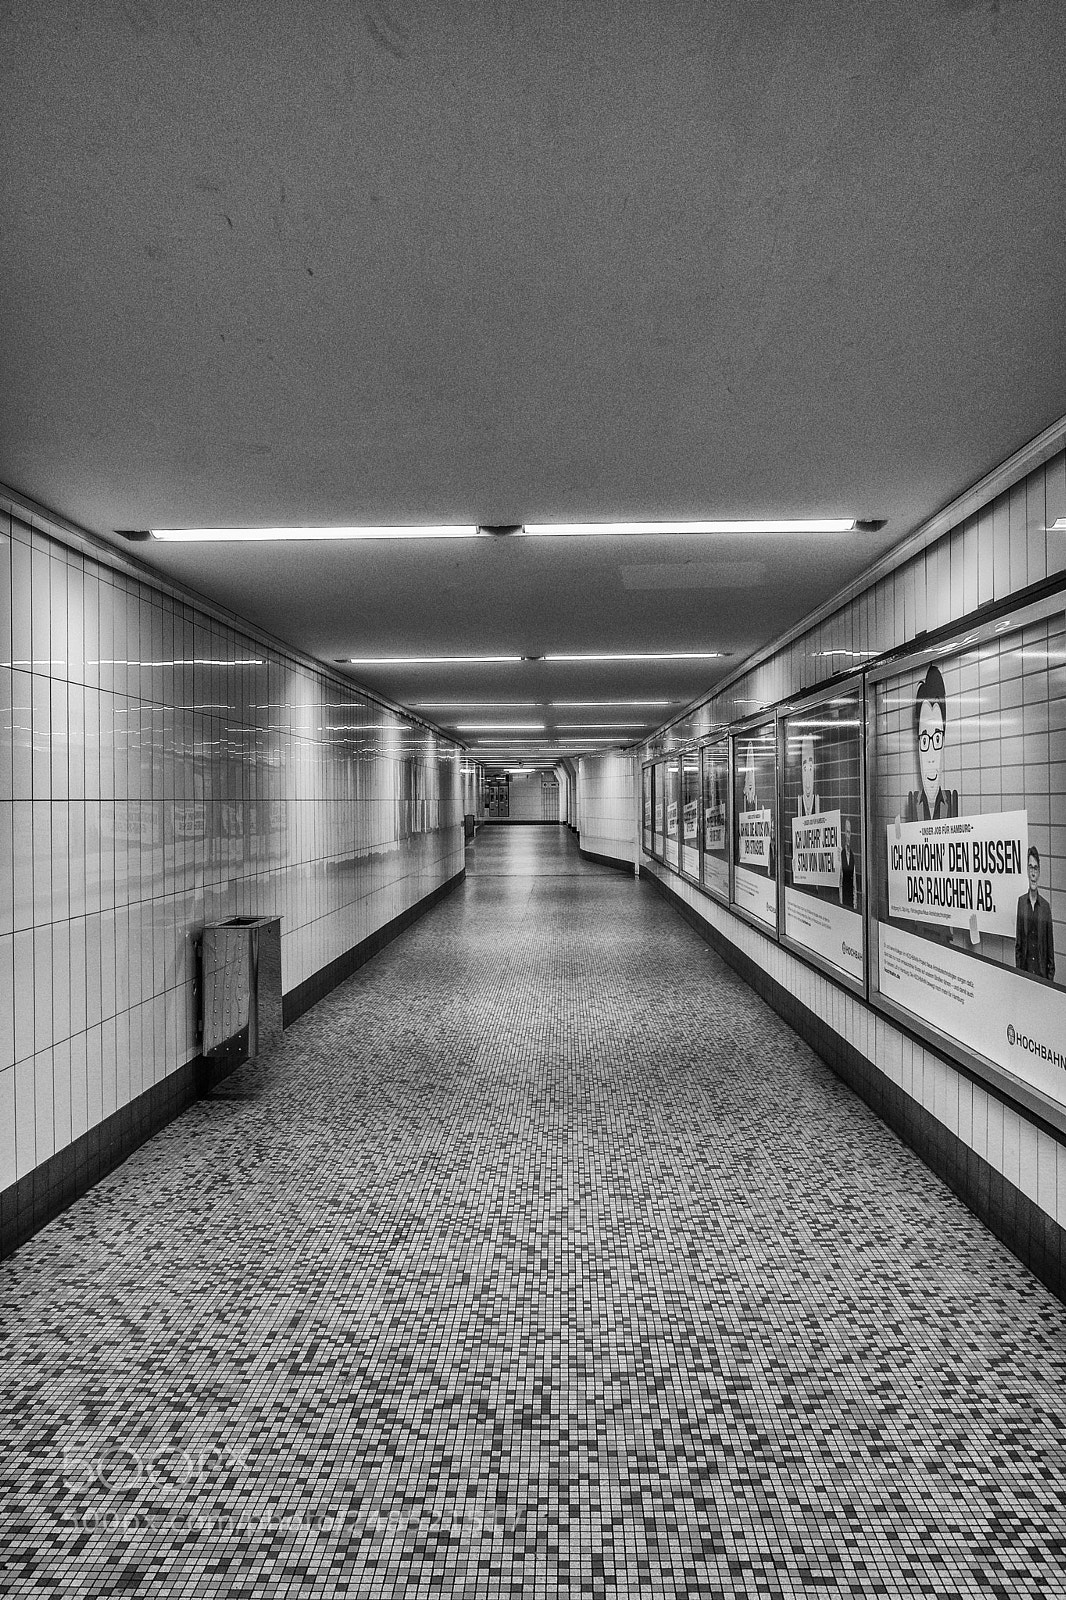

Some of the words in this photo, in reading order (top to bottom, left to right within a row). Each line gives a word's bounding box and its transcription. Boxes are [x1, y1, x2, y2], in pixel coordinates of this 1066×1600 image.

[890, 844, 904, 871] ICH
[949, 841, 970, 873] DEN
[973, 839, 1022, 875] BUSSEN
[907, 876, 925, 904] DAS
[926, 876, 974, 910] RAUCHEN
[976, 879, 997, 913] AB.
[1016, 1032, 1066, 1071] HOCHBAHN
